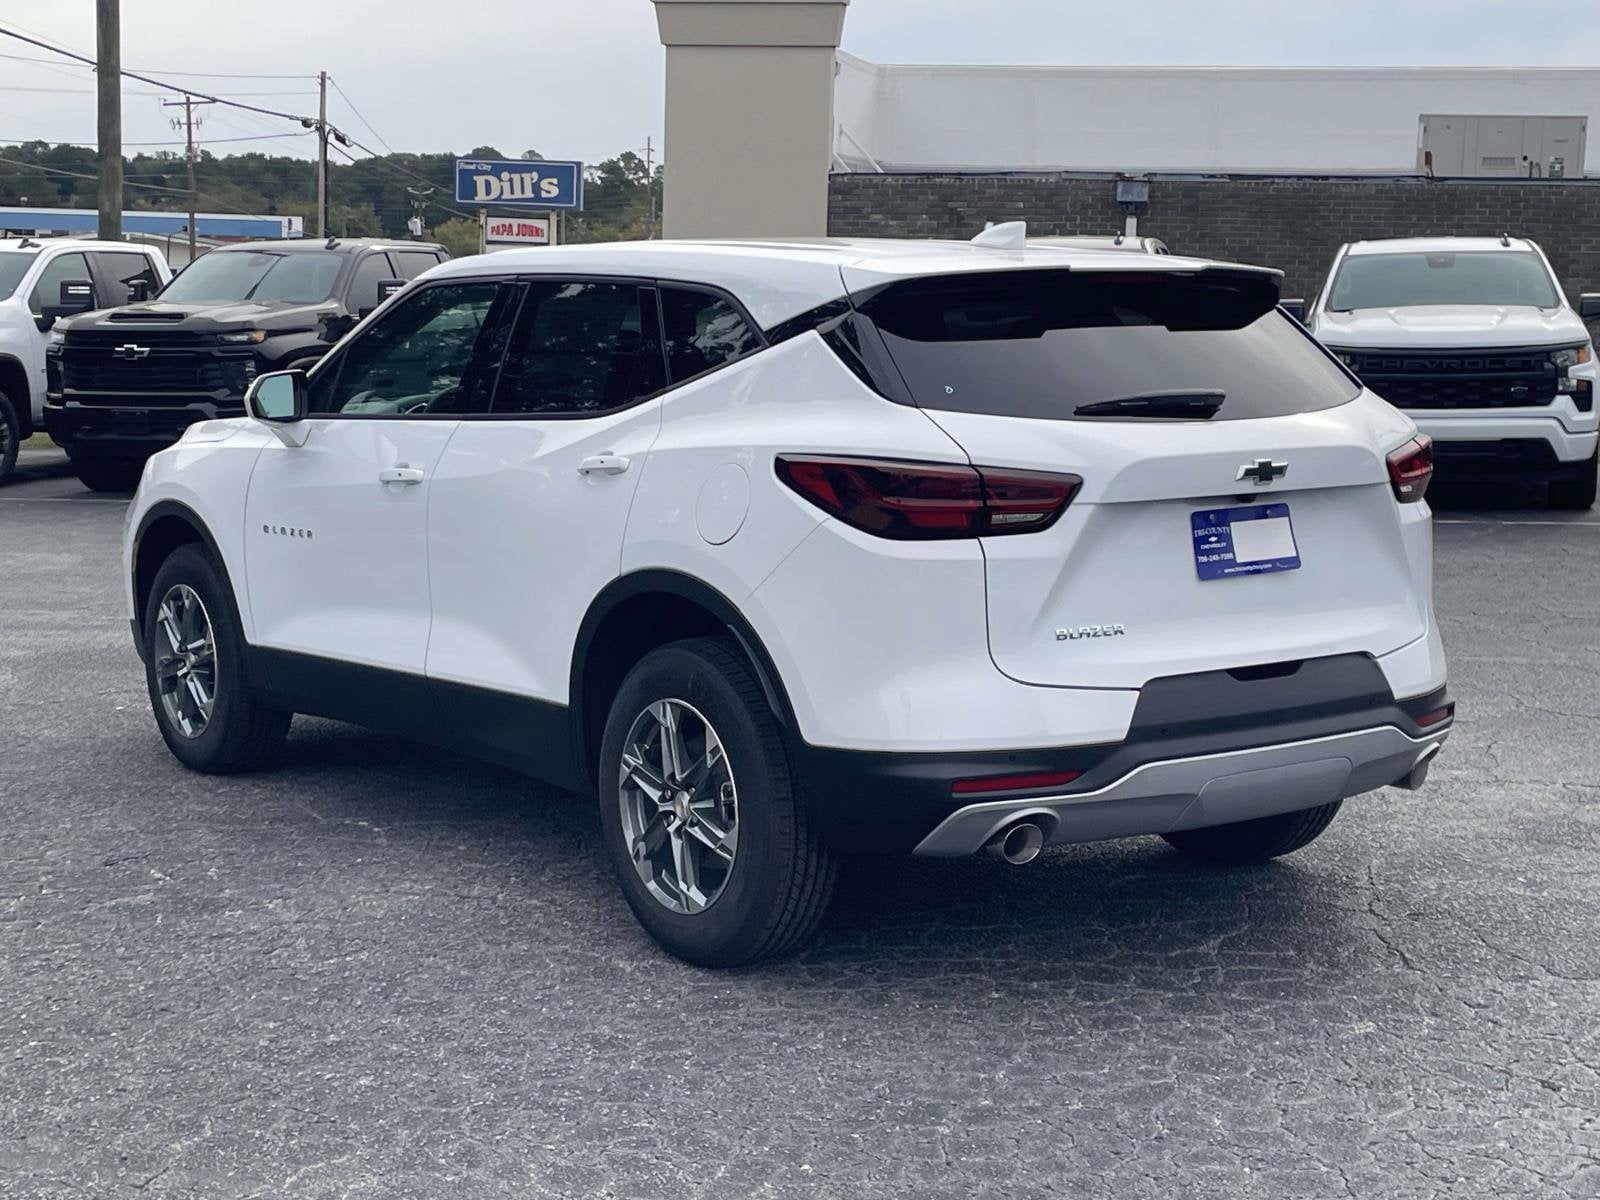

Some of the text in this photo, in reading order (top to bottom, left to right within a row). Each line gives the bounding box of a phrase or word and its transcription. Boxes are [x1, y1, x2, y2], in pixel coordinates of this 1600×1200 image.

[473, 171, 560, 201] Dill's
[490, 223, 514, 236] PAPA
[1362, 355, 1544, 371] CHEVROLET
[263, 524, 313, 539] BLAZER
[1055, 623, 1125, 641] BLAZER
